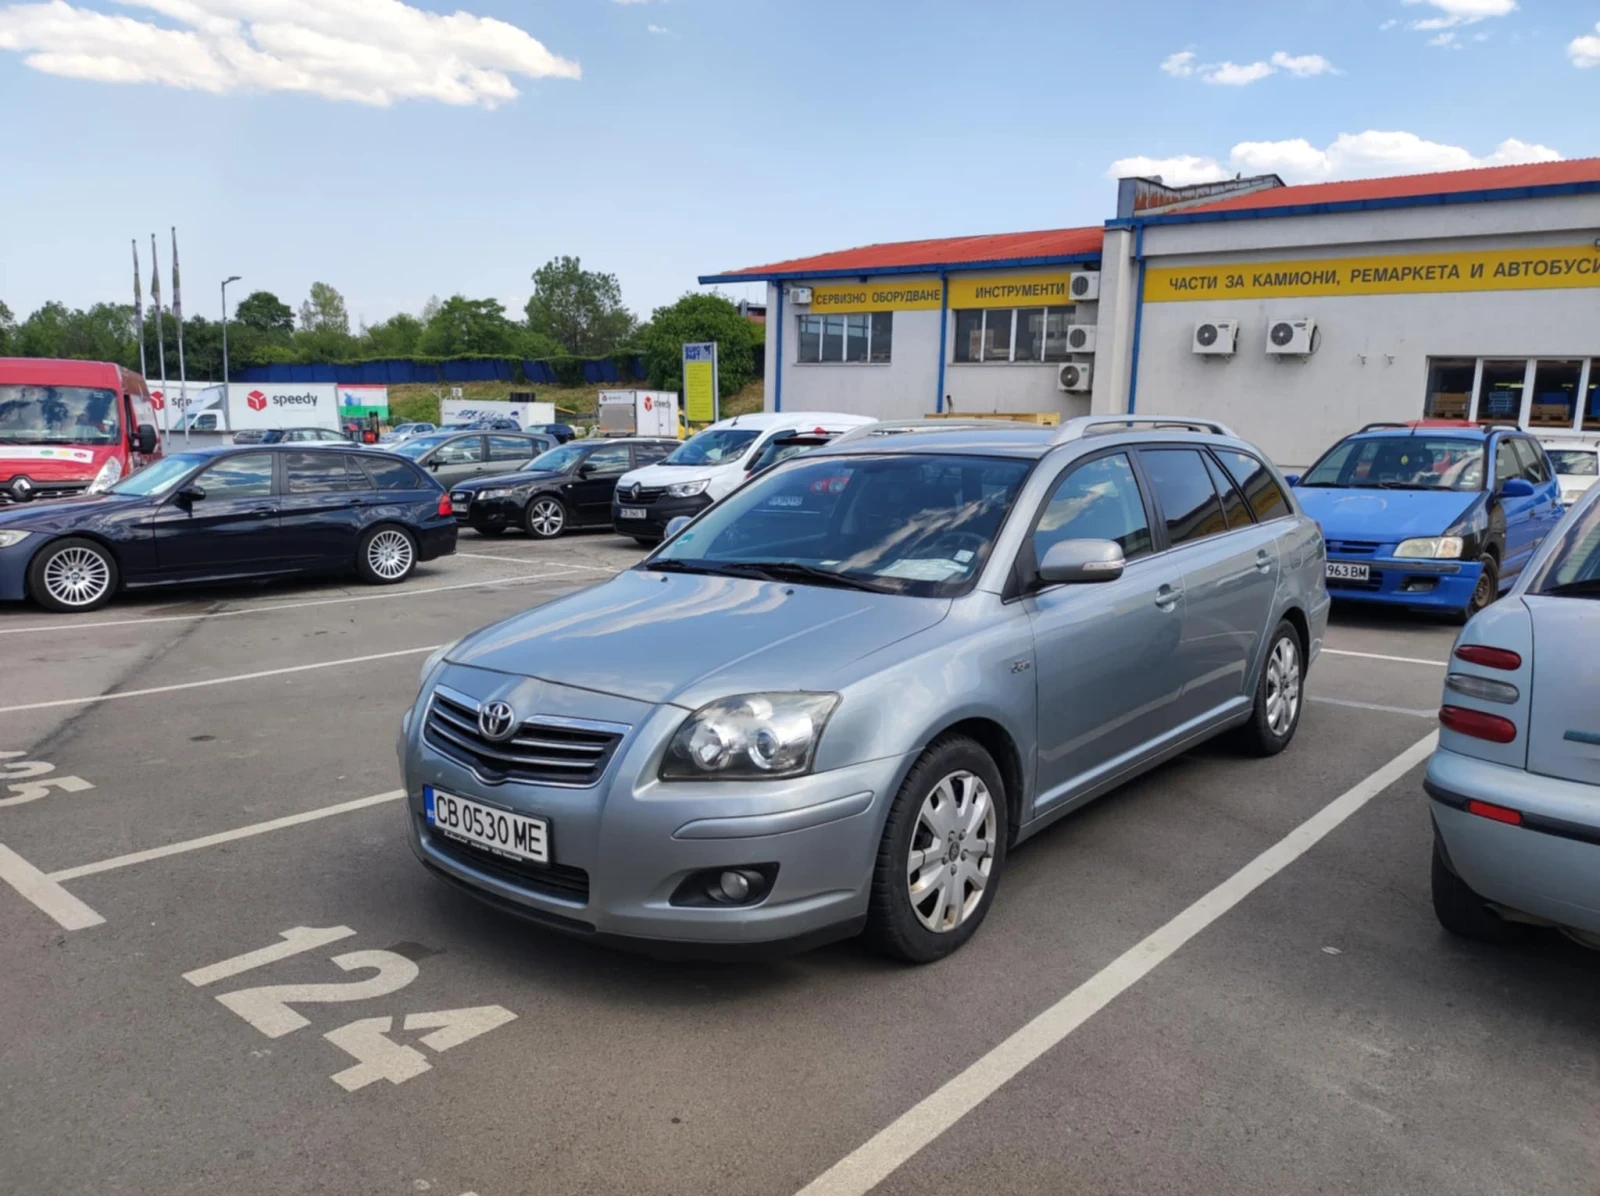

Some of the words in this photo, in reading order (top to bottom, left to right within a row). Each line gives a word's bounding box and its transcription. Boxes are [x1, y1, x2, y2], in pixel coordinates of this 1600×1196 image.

[1170, 275, 1217, 291] ЧАСТИ
[1225, 274, 1244, 289] ЗА
[1252, 270, 1340, 287] КАМИОНИ,
[1350, 264, 1460, 283] РЕМАРКЕТА
[1470, 263, 1484, 279] И
[816, 292, 866, 305] СЕРВИЗНО
[872, 289, 940, 303] ОБОРУДВАНЕ
[976, 283, 1065, 299] ИНСТРУМЕНТИ
[171, 397, 192, 408] spe
[272, 392, 318, 406] speedy
[1327, 564, 1349, 577] 963
[1350, 566, 1367, 578] BM
[436, 796, 459, 828] CB
[463, 805, 509, 845] 0530
[513, 819, 542, 855] ME
